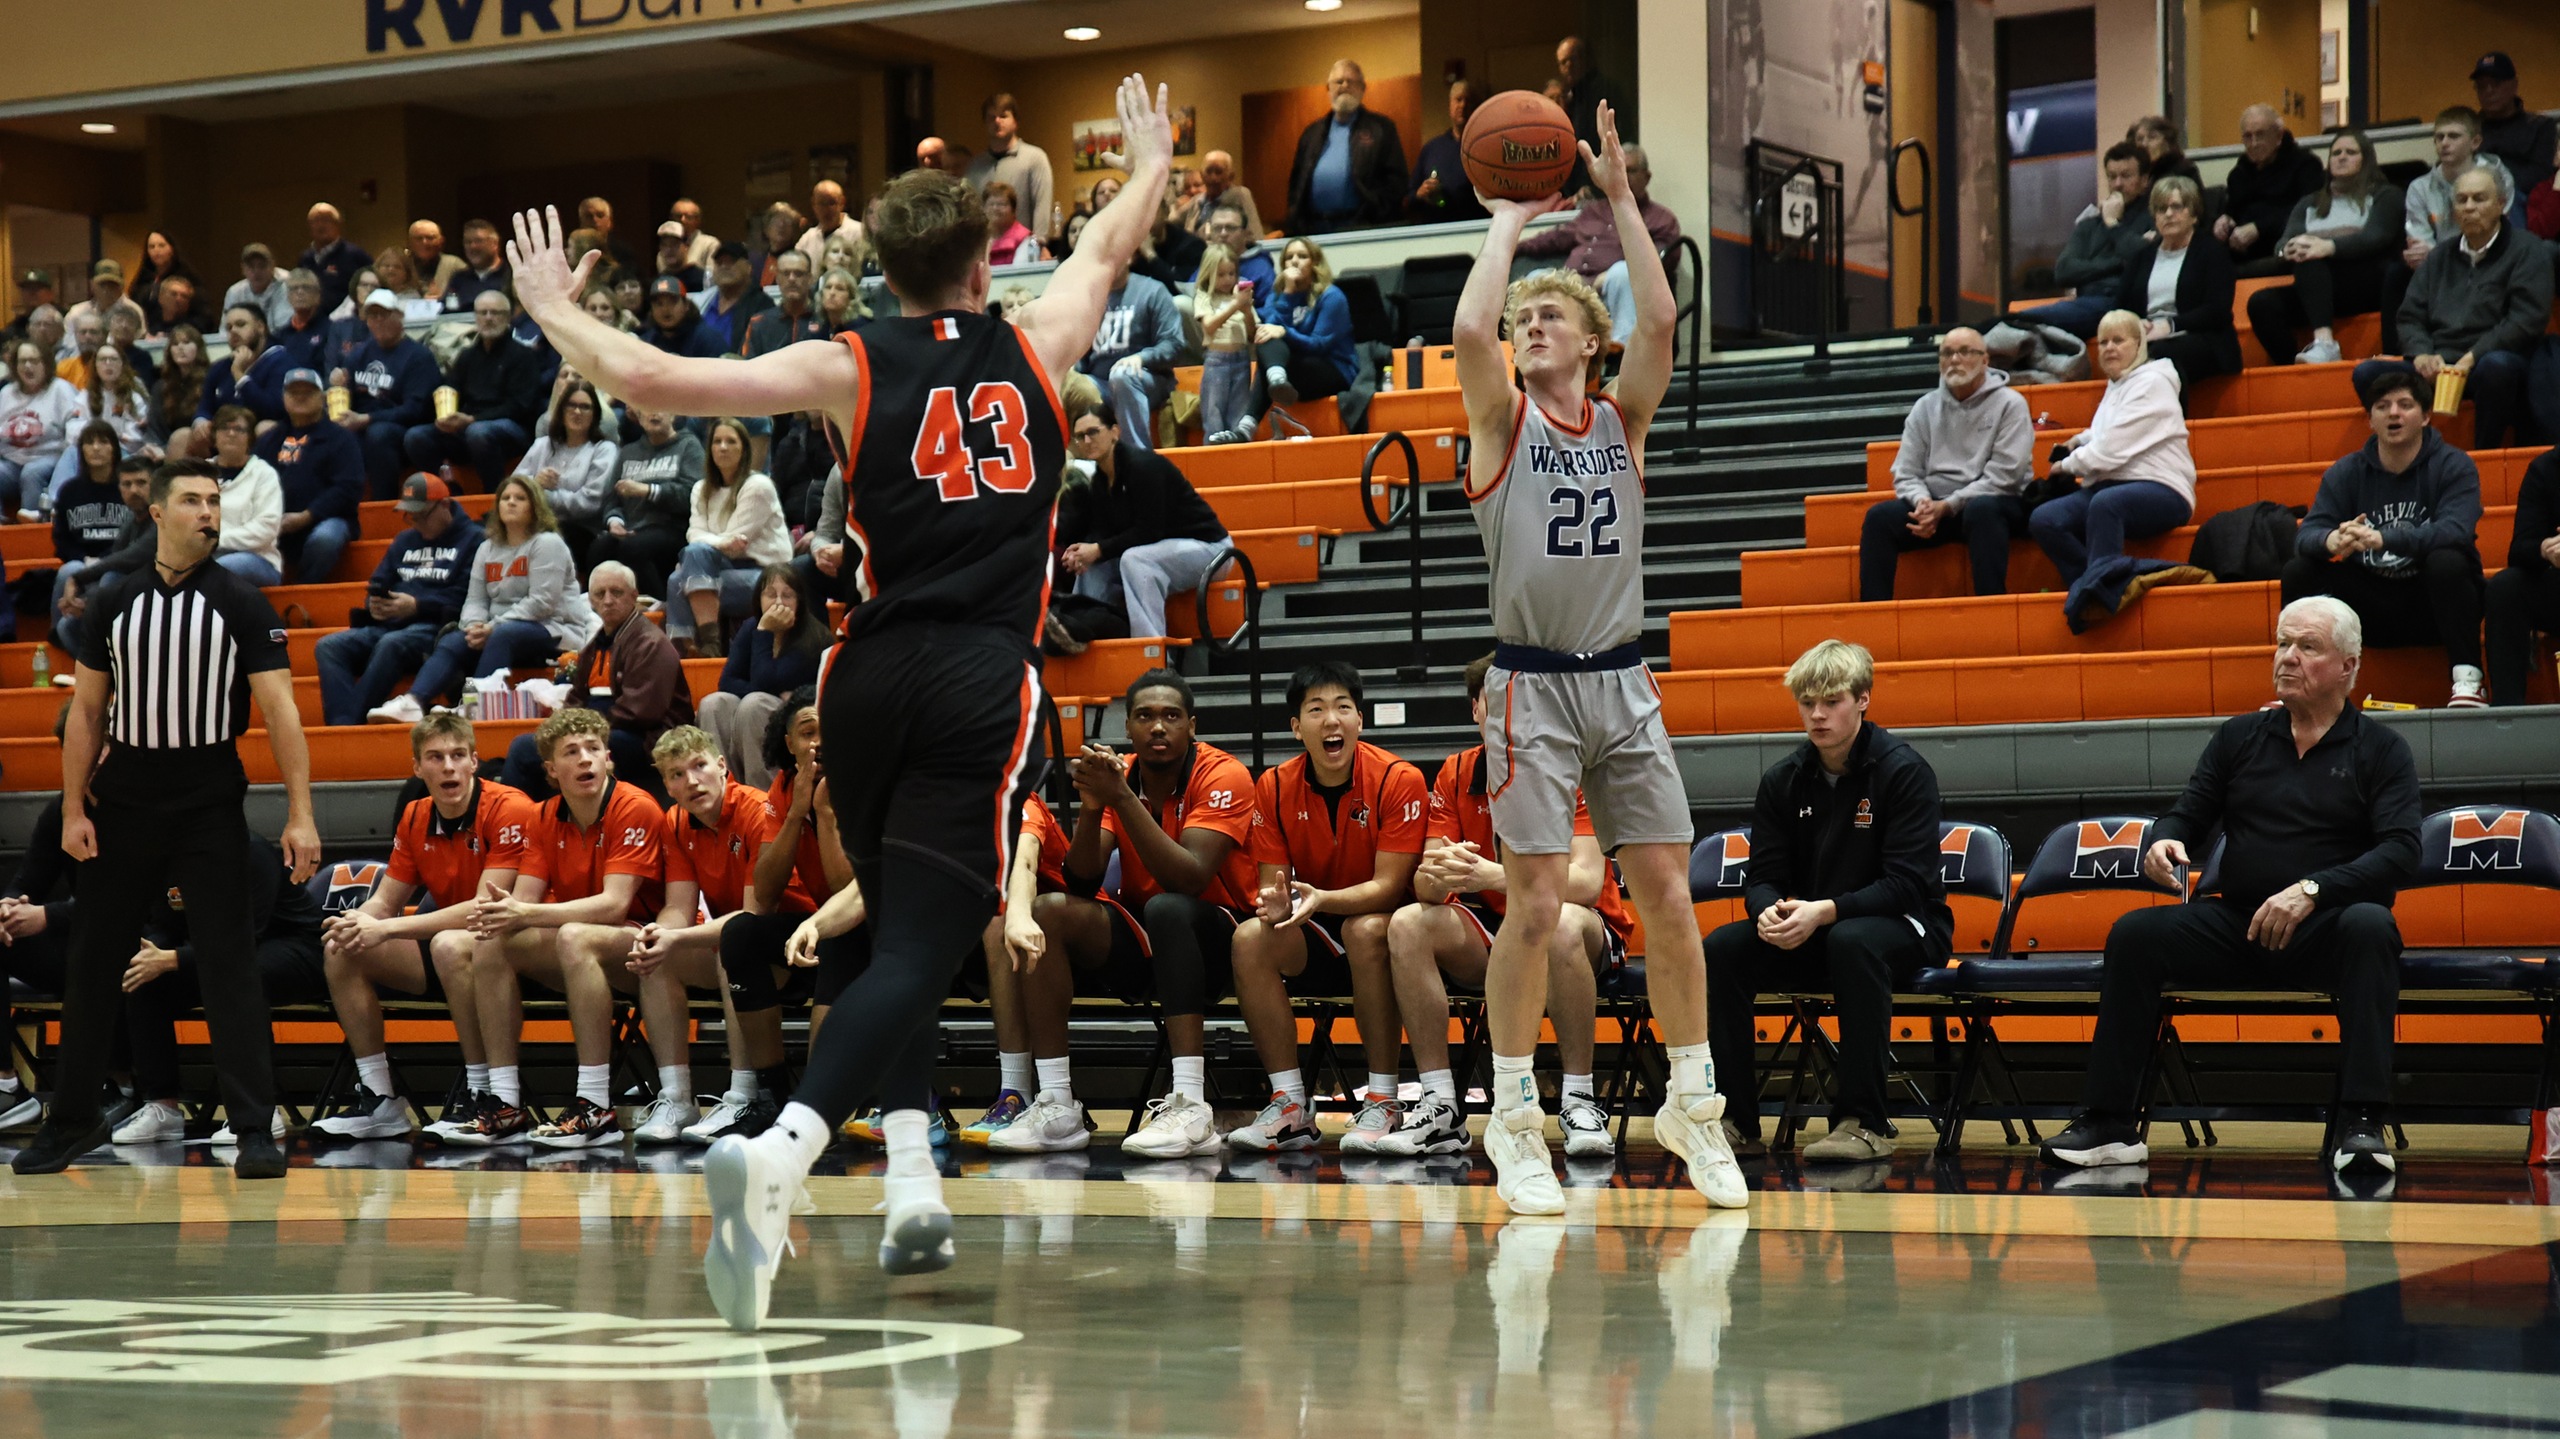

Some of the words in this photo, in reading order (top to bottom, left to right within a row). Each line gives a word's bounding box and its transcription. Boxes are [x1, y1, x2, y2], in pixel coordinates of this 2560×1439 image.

[910, 381, 1036, 502] 43
[1528, 443, 1627, 477] WARRIORS
[1545, 485, 1621, 558] 22
[1207, 790, 1233, 809] 32
[500, 825, 522, 844] 25
[623, 827, 646, 847] 22
[2070, 820, 2149, 879] M
[2444, 810, 2531, 870] M
